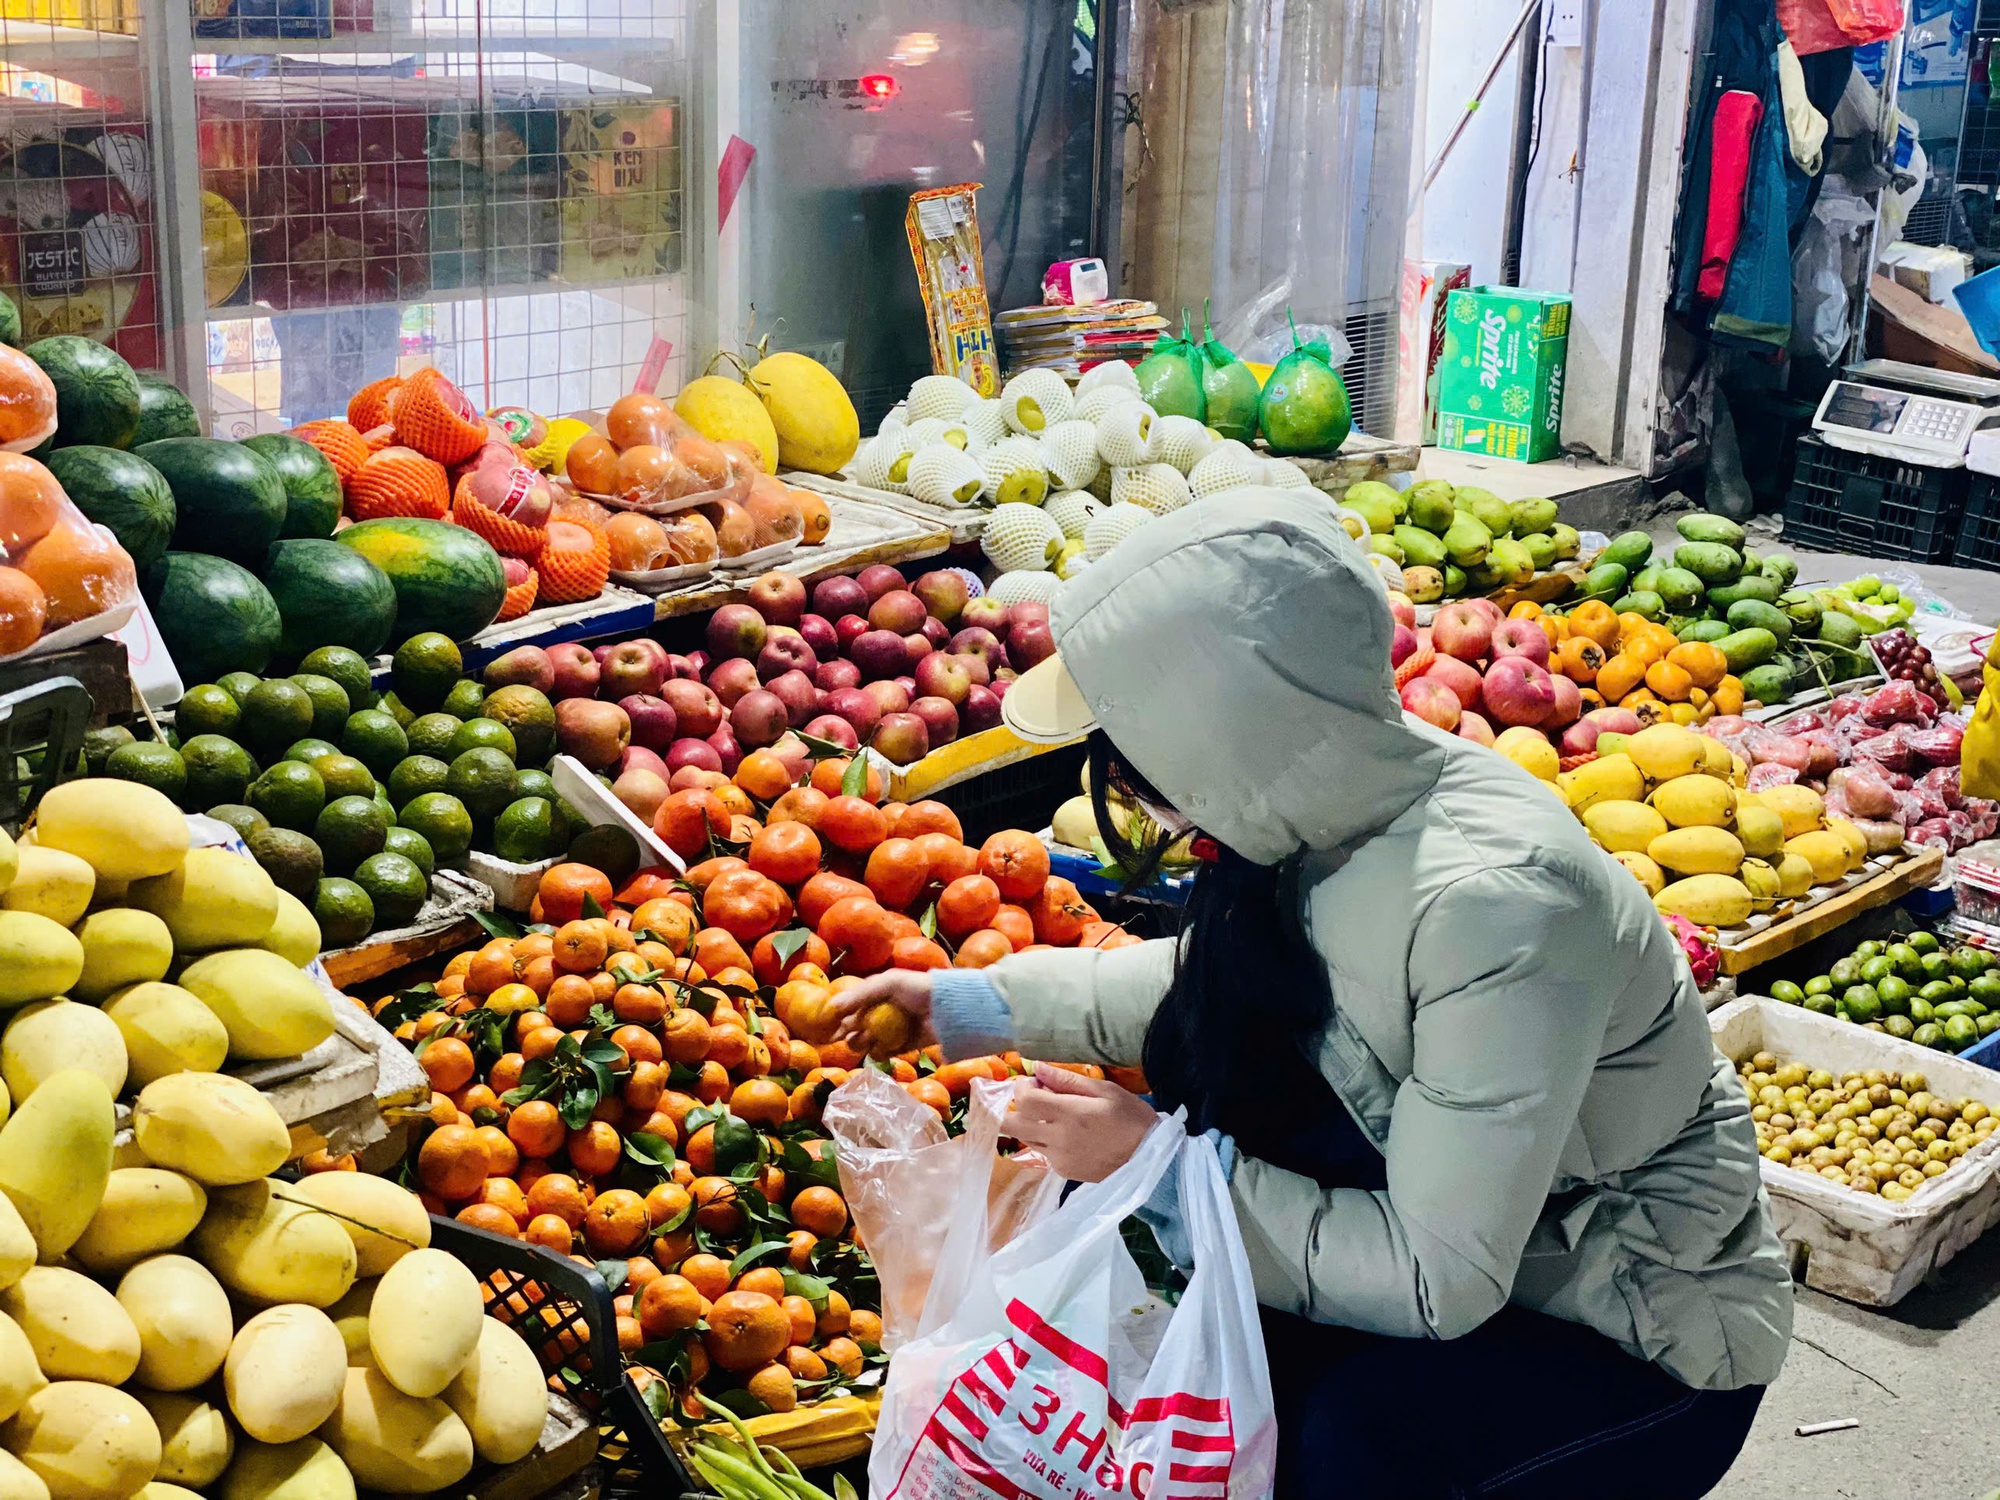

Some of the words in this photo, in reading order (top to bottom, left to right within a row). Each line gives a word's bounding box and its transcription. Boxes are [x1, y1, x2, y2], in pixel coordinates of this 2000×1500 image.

[1479, 308, 1506, 390] Sprite
[1545, 363, 1562, 433] Sprite
[1018, 1384, 1060, 1435] 3
